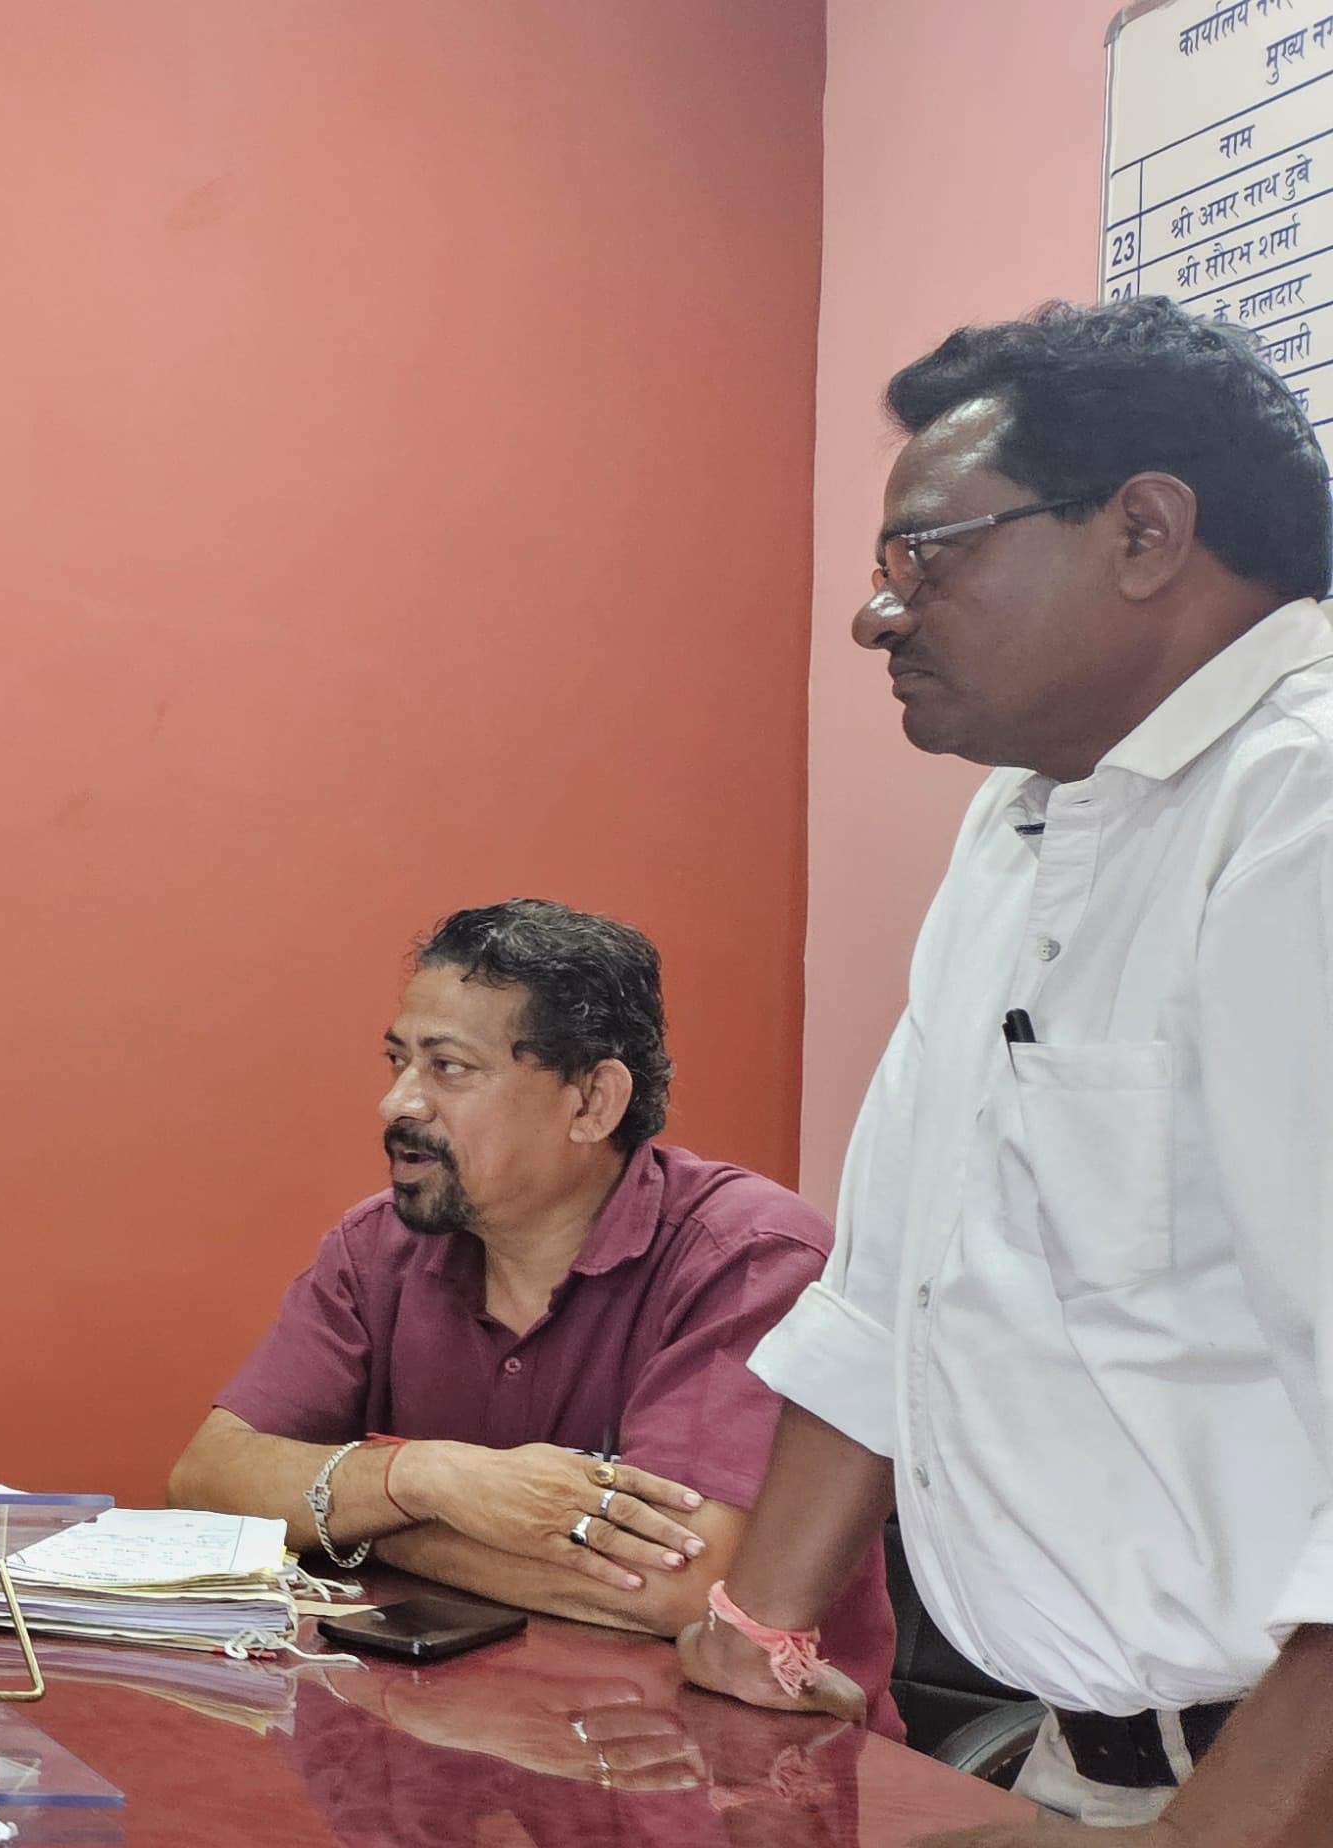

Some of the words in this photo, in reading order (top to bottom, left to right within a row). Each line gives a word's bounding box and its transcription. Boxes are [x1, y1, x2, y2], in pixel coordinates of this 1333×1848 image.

[1266, 28, 1309, 85] मुख्य
[1220, 124, 1255, 159] नाम
[1171, 206, 1193, 239] श्री
[1199, 191, 1239, 226] अमर
[1244, 172, 1280, 206] नाथ
[1283, 154, 1313, 201] दुबे
[1111, 231, 1135, 267] 23
[1177, 255, 1200, 287] श्री
[1205, 240, 1253, 280] सौरभ
[1259, 213, 1301, 259] शर्मा
[1239, 273, 1312, 323] हालदार
